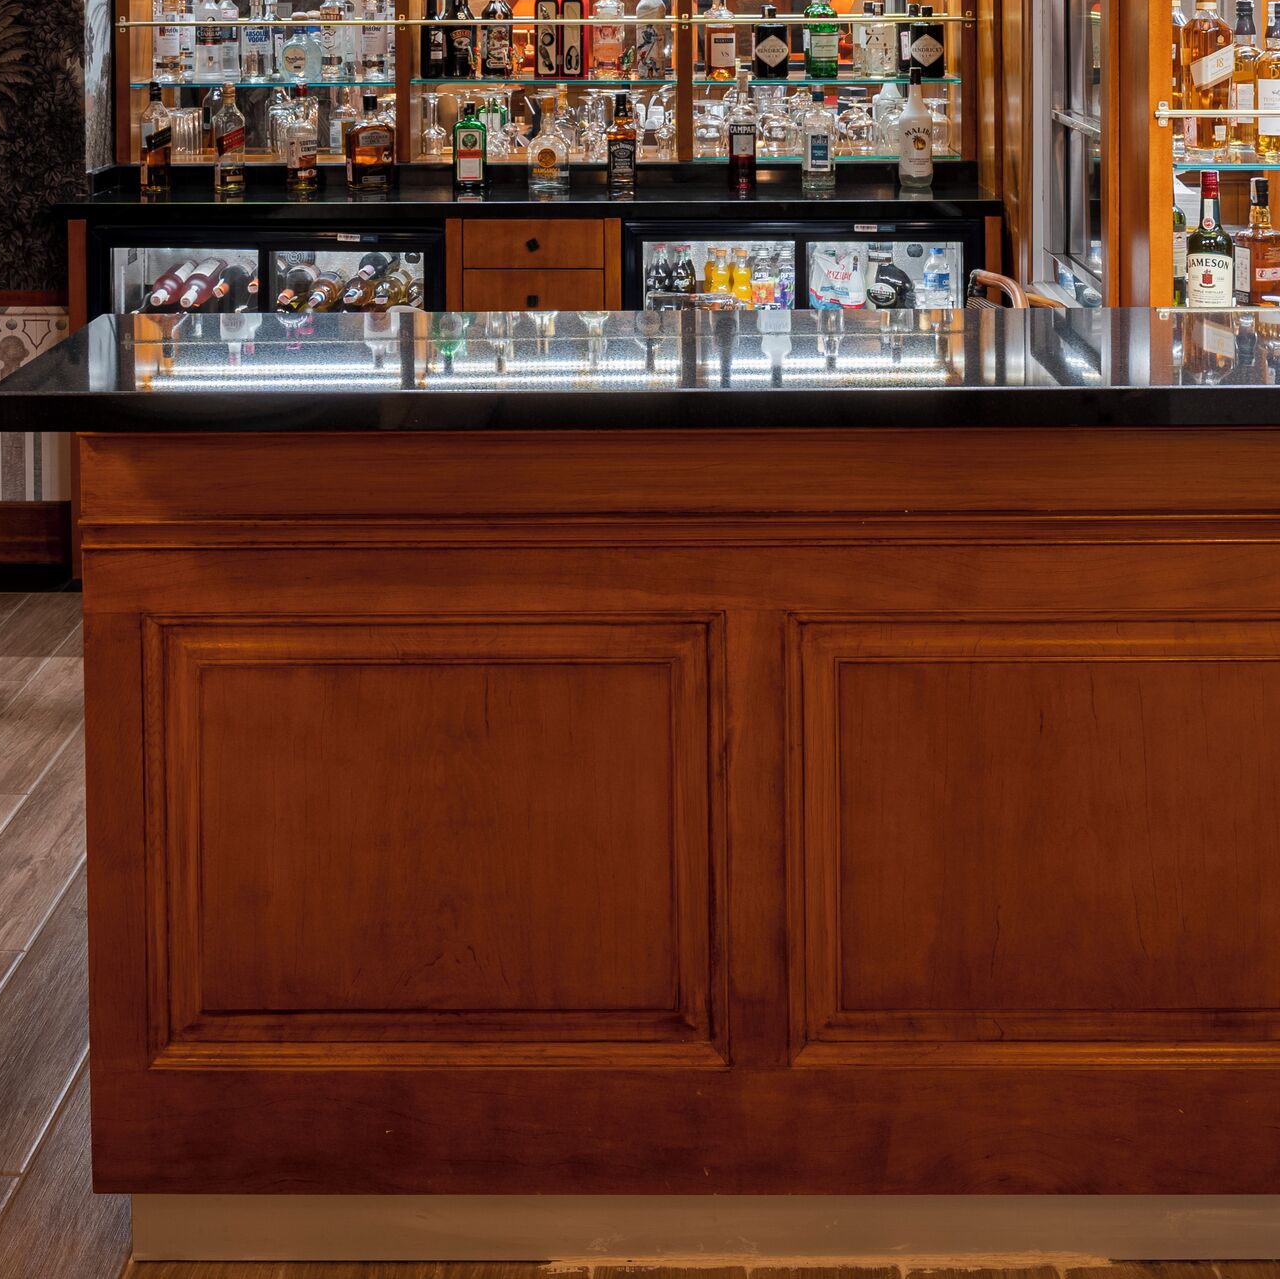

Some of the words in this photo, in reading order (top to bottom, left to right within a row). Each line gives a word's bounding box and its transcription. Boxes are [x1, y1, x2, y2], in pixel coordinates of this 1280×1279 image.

[247, 35, 269, 43] VODKA
[1216, 58, 1224, 68] 18
[1189, 258, 1229, 269] JAMESON
